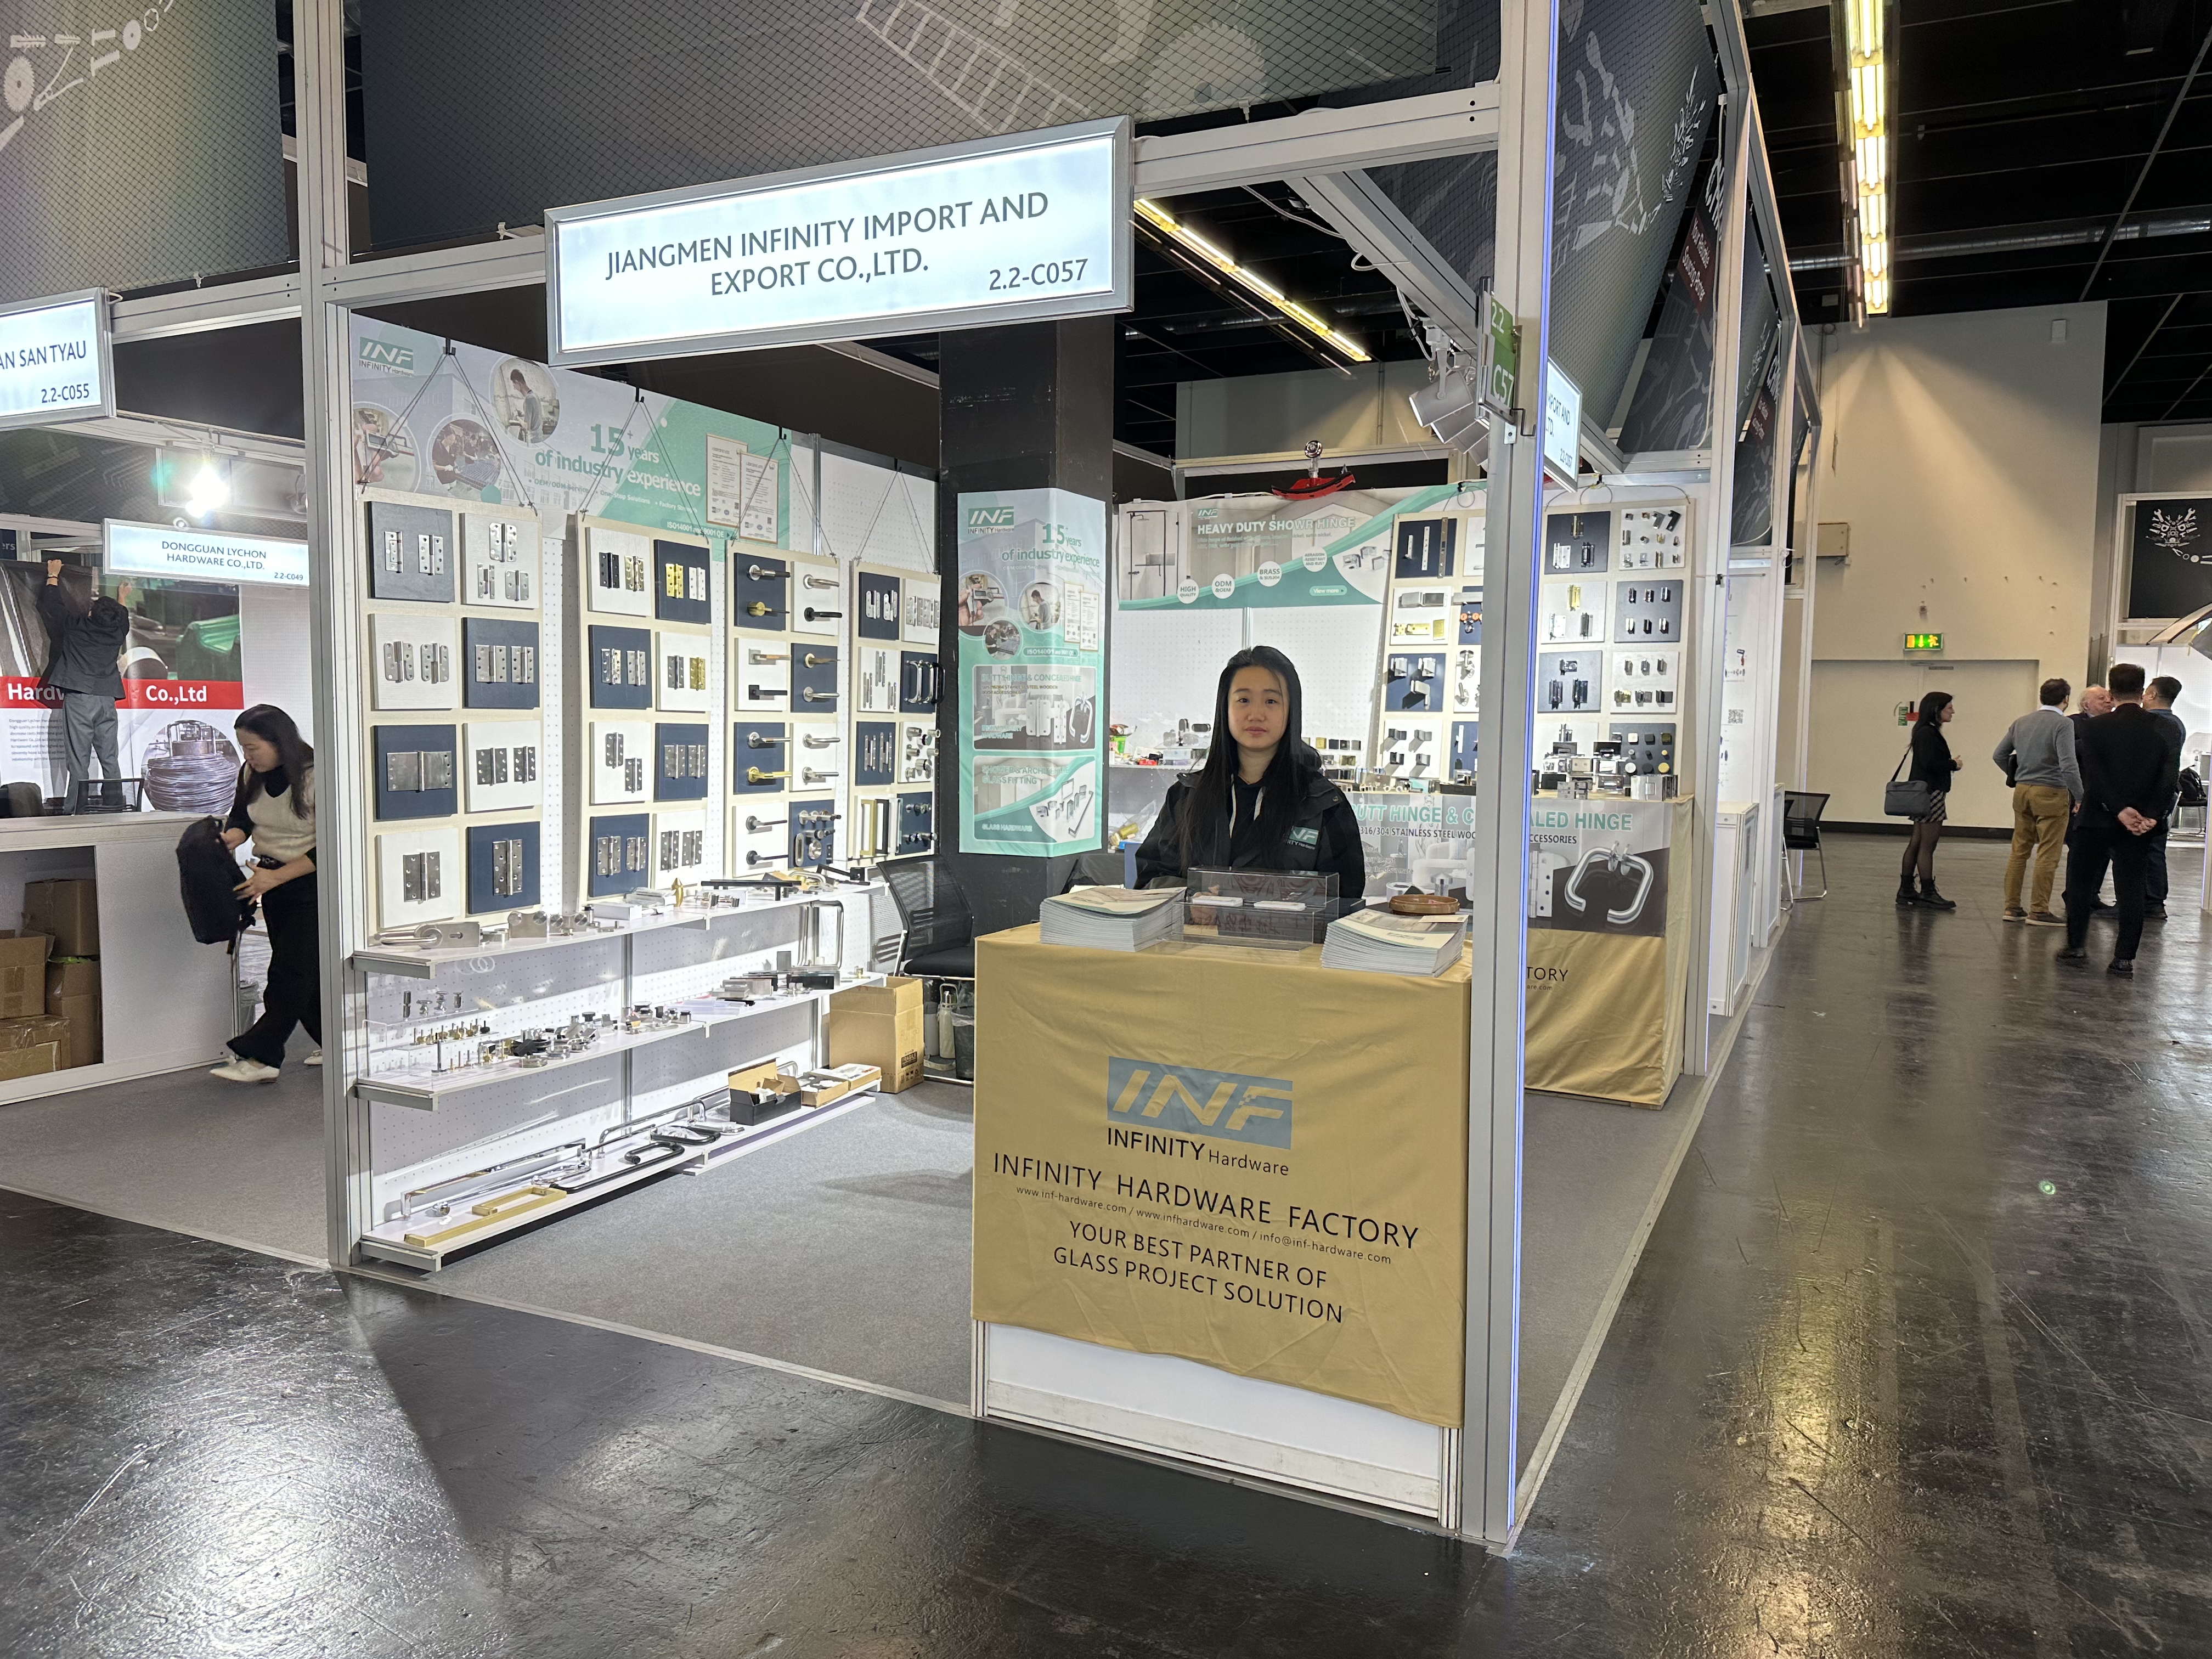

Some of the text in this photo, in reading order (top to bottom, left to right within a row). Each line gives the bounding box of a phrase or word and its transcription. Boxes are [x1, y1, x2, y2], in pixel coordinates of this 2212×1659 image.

[606, 191, 1049, 280] JIANGMEN INFINITY IMPORT AND
[711, 247, 929, 296] EXPORT CO.,LTD.
[989, 258, 1088, 291] 2.2-C057
[1491, 302, 1505, 334] 2.2
[19, 346, 47, 367] SAN
[49, 340, 86, 363] TYAU
[361, 341, 414, 365] INF
[359, 359, 392, 374] INFINITY
[41, 383, 89, 403] 2.2-C055
[1493, 364, 1515, 407] C57
[1547, 390, 1570, 425] MPORT AND
[628, 445, 659, 464] years
[535, 449, 701, 496] of industry experience
[534, 478, 589, 494] OEM/ODM Service
[627, 494, 650, 504] Solutions
[659, 501, 676, 510] Factory
[667, 521, 692, 532] ISO14001
[969, 508, 1014, 525] INF
[1065, 537, 1082, 547] years
[1198, 516, 1356, 535] HEAVY DUTY SHOWR HINGE
[162, 541, 267, 558] DONGGUAN LYCHON
[167, 553, 265, 570] HARDWARE CO.,LTD.
[1001, 546, 1100, 567] of industry experience
[274, 572, 303, 581] 2.2-C049
[981, 674, 1001, 682] BUTT
[1003, 674, 1027, 682] HINGE
[145, 685, 207, 706] Co.,Ltd
[981, 775, 1007, 784] GLASS
[1390, 805, 1442, 823] HINGE
[1446, 806, 1458, 825] &
[1574, 812, 1633, 831] HINGE
[1359, 826, 1389, 836] 316/304
[1391, 827, 1431, 837] STAINLESS
[1433, 830, 1455, 838] STEEL
[1111, 1069, 1293, 1132] INF
[1107, 1127, 1290, 1176] INFINITY Hardware
[993, 1153, 1419, 1250] INFINITY HARDWARE FACTORY
[1016, 1186, 1392, 1265] www.inf-hardware.com / www.infhardware.com / info@inf-hardware.com
[1069, 1220, 1328, 1289] YOUR BEST PARTNER OF
[1053, 1246, 1344, 1324] GLASS PROJECT SOLUTION
